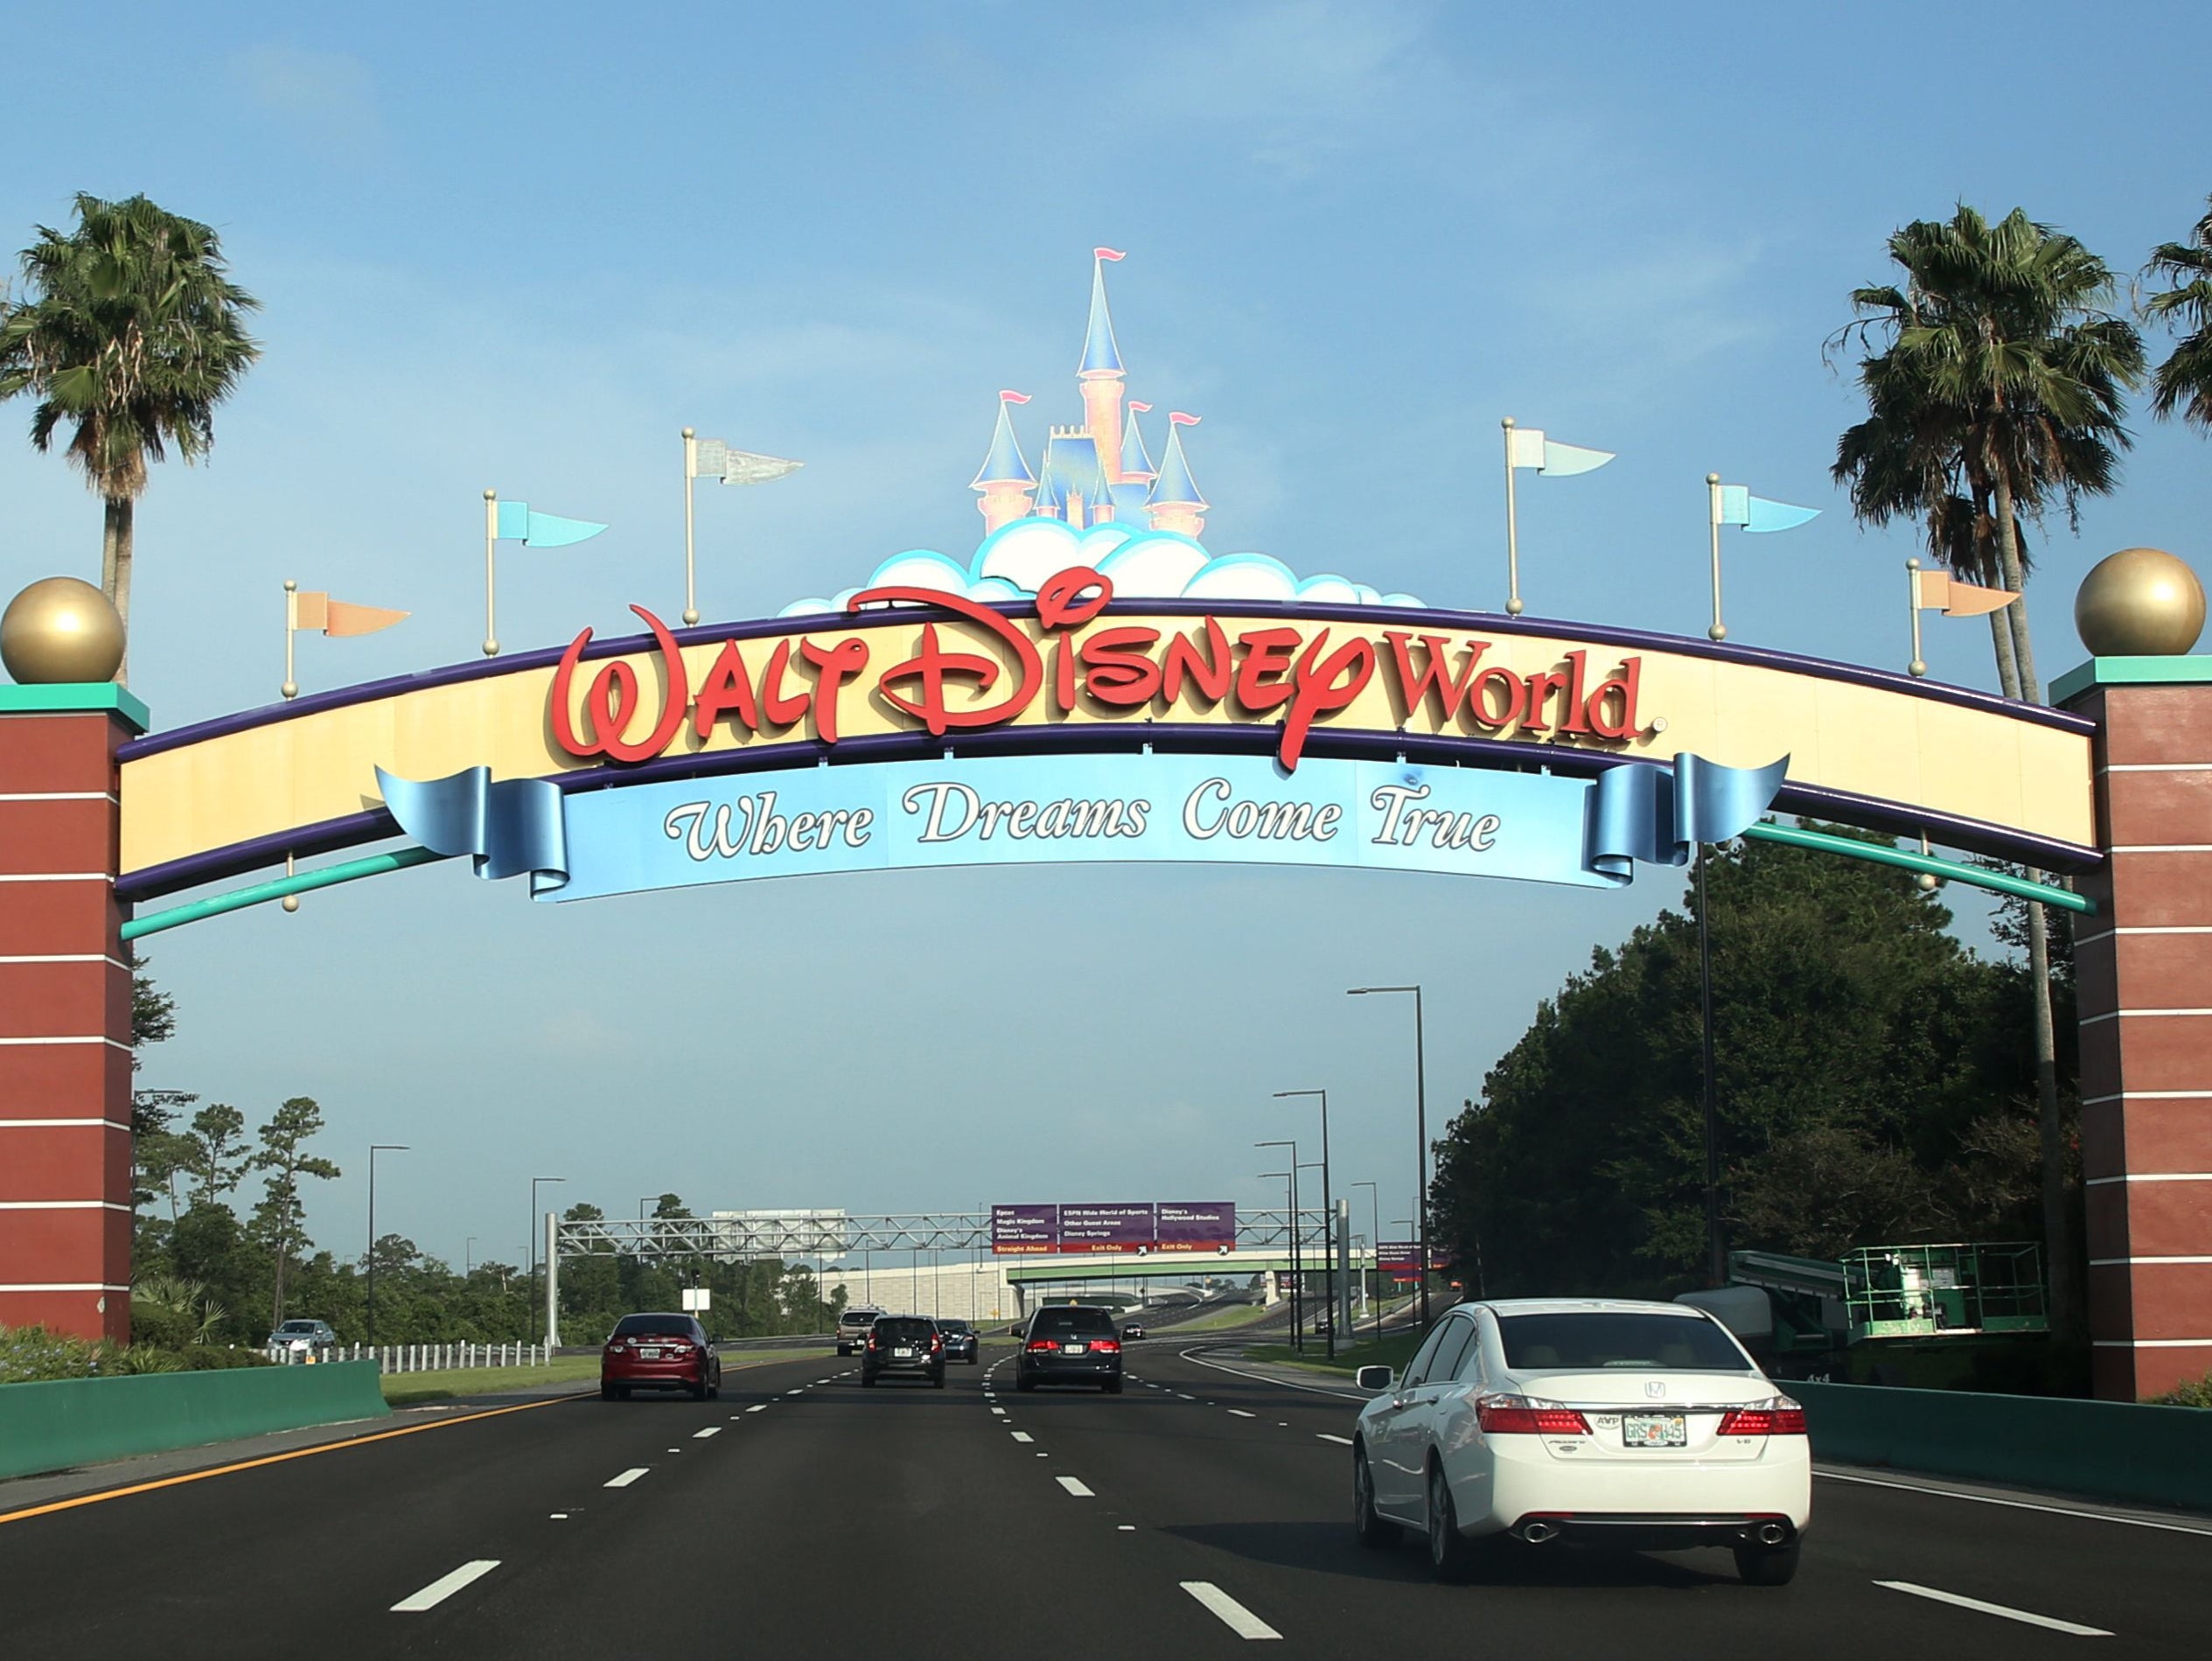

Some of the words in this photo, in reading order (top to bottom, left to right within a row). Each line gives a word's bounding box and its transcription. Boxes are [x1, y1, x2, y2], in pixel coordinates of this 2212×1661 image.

[1382, 630, 1643, 741] World
[663, 791, 874, 861] Where
[902, 780, 1151, 855] Dreams
[1183, 777, 1343, 842] Come
[1370, 784, 1502, 852] True
